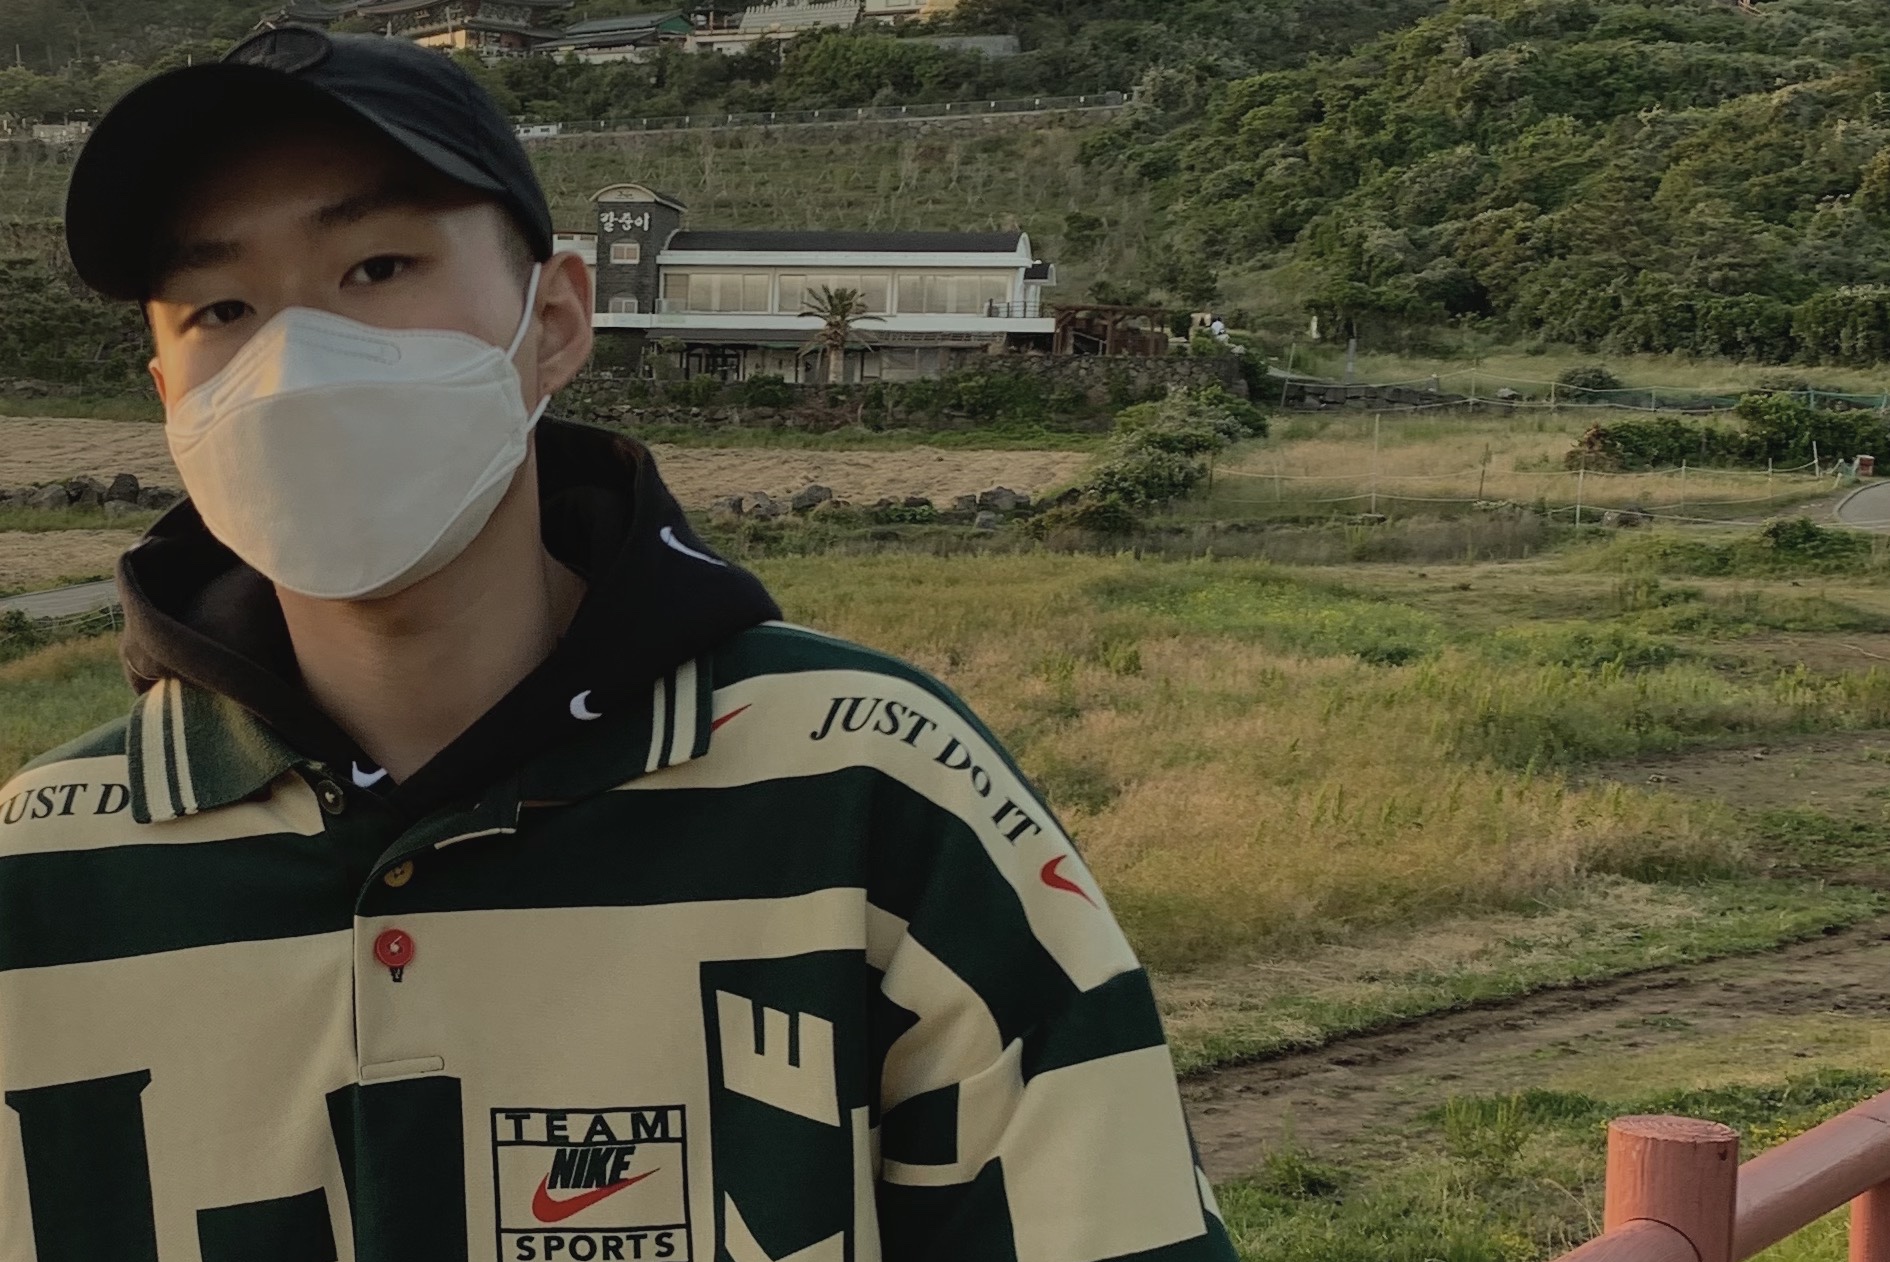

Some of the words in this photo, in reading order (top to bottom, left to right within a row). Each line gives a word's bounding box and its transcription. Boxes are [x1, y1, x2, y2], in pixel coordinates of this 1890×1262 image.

[810, 697, 937, 748] JUST
[934, 735, 992, 798] DO
[991, 800, 1041, 847] IT
[3, 783, 88, 825] UST
[93, 783, 131, 815] D
[504, 1110, 671, 1143] TEAM
[547, 1145, 636, 1190] NIKE
[516, 1232, 675, 1262] SPORTS
